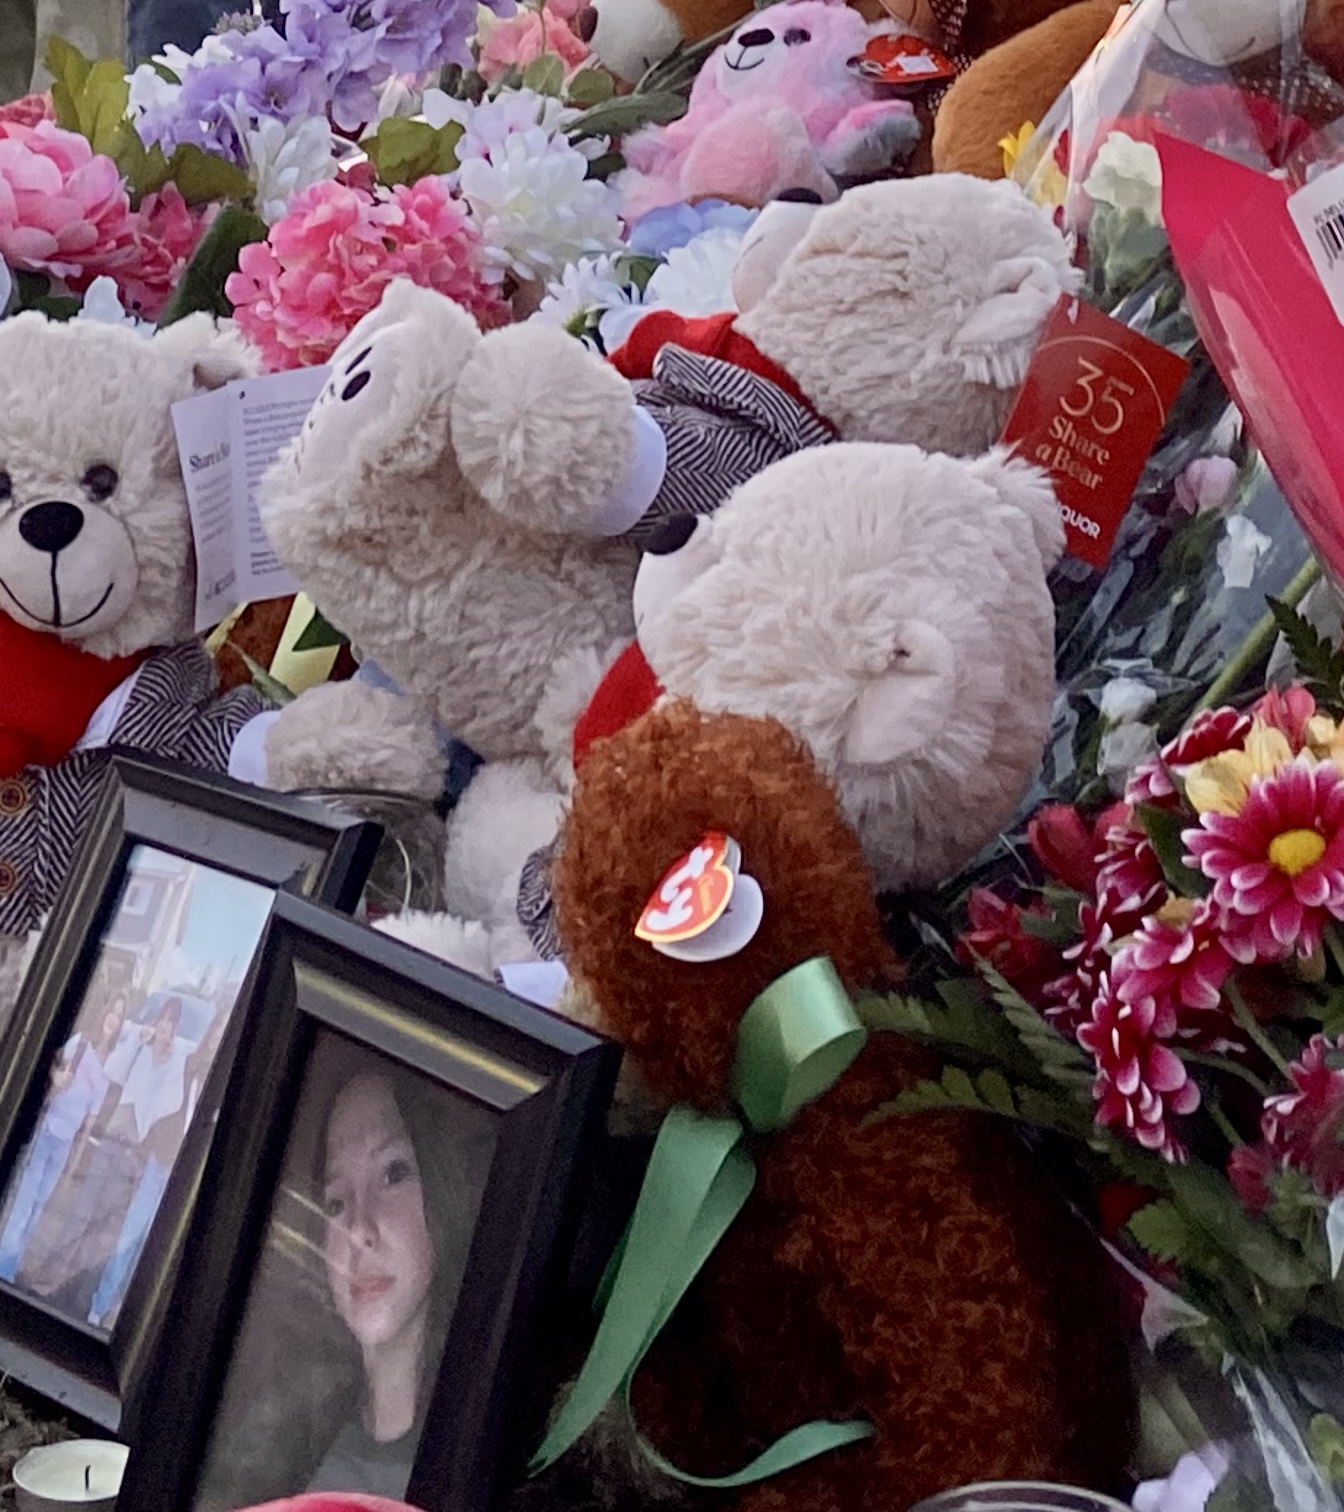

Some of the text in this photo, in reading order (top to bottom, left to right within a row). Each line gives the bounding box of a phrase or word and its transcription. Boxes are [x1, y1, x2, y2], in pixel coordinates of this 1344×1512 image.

[1059, 356, 1135, 436] 35
[1047, 414, 1110, 466] Share
[1035, 443, 1104, 490] a Bear
[1058, 501, 1101, 540] QUOR
